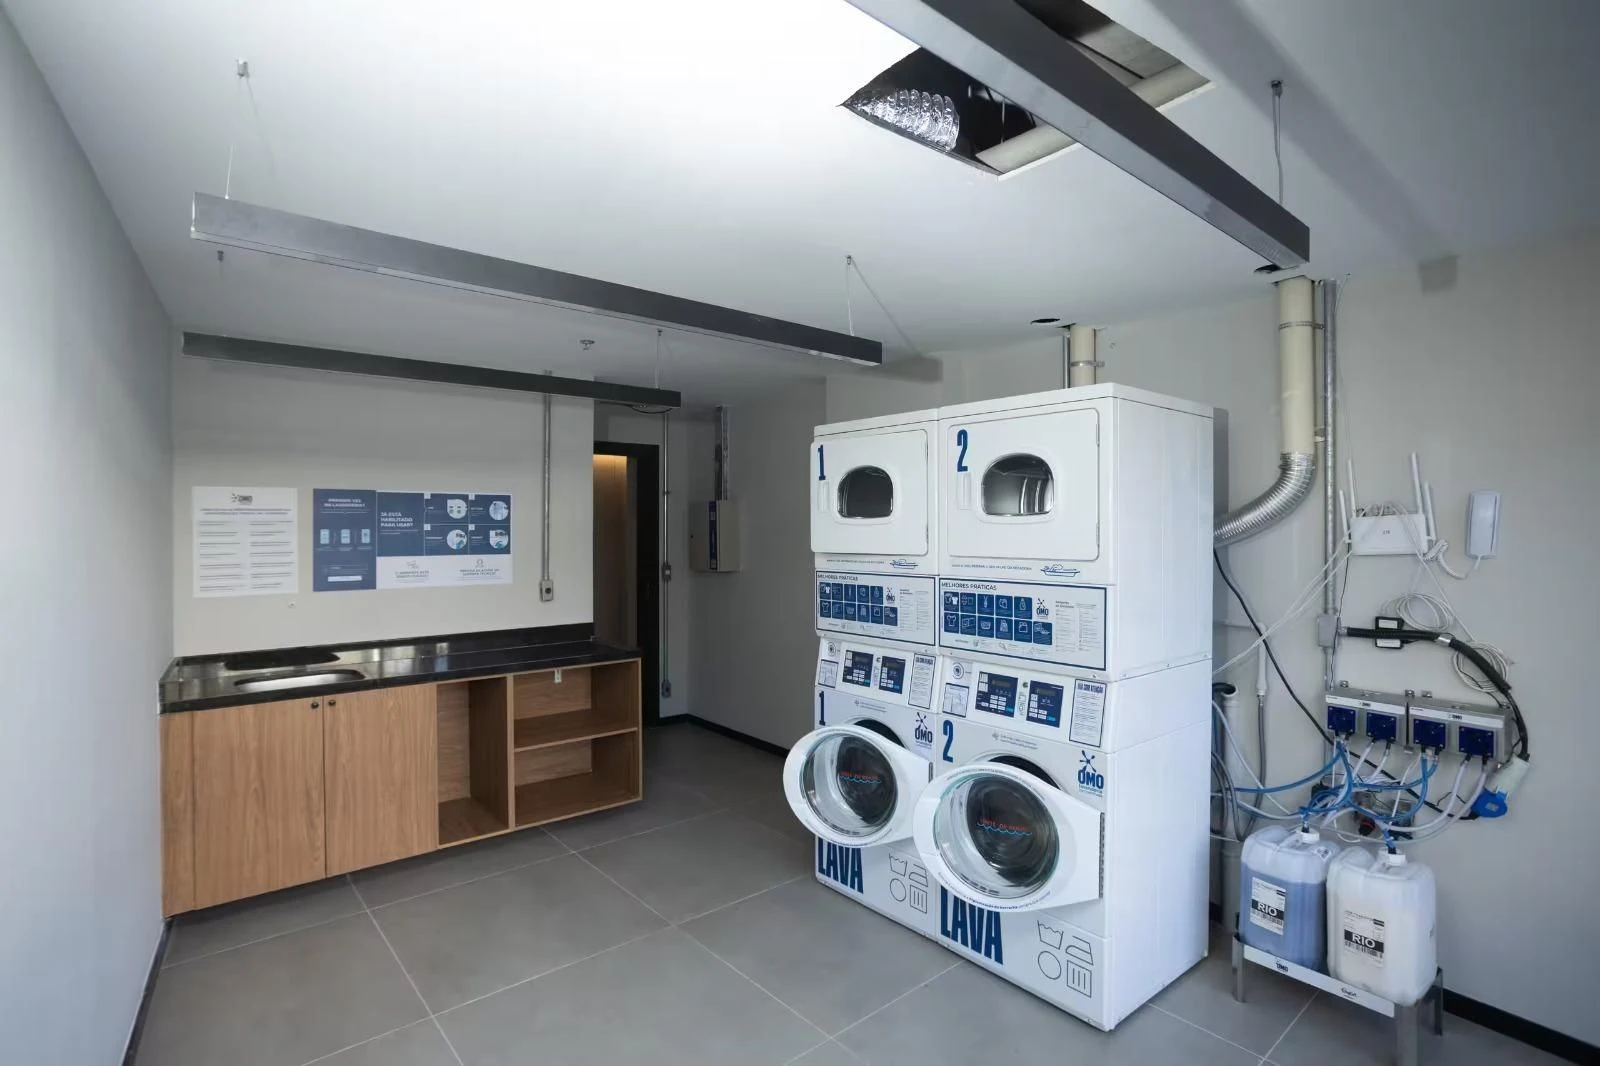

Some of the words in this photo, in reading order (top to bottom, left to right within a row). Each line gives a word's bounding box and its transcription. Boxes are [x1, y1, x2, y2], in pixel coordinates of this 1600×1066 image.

[817, 444, 826, 481] 1
[957, 429, 969, 473] 2
[941, 581, 969, 590] MELHORES
[1036, 606, 1049, 617] OMO
[818, 691, 826, 727] 1
[914, 727, 933, 744] OMO
[943, 719, 954, 764] 2
[1078, 768, 1104, 790] OMO
[818, 841, 864, 894] LAVA
[1257, 902, 1277, 917] RIO
[940, 885, 1004, 966] LAVA
[1352, 932, 1375, 949] RIO
